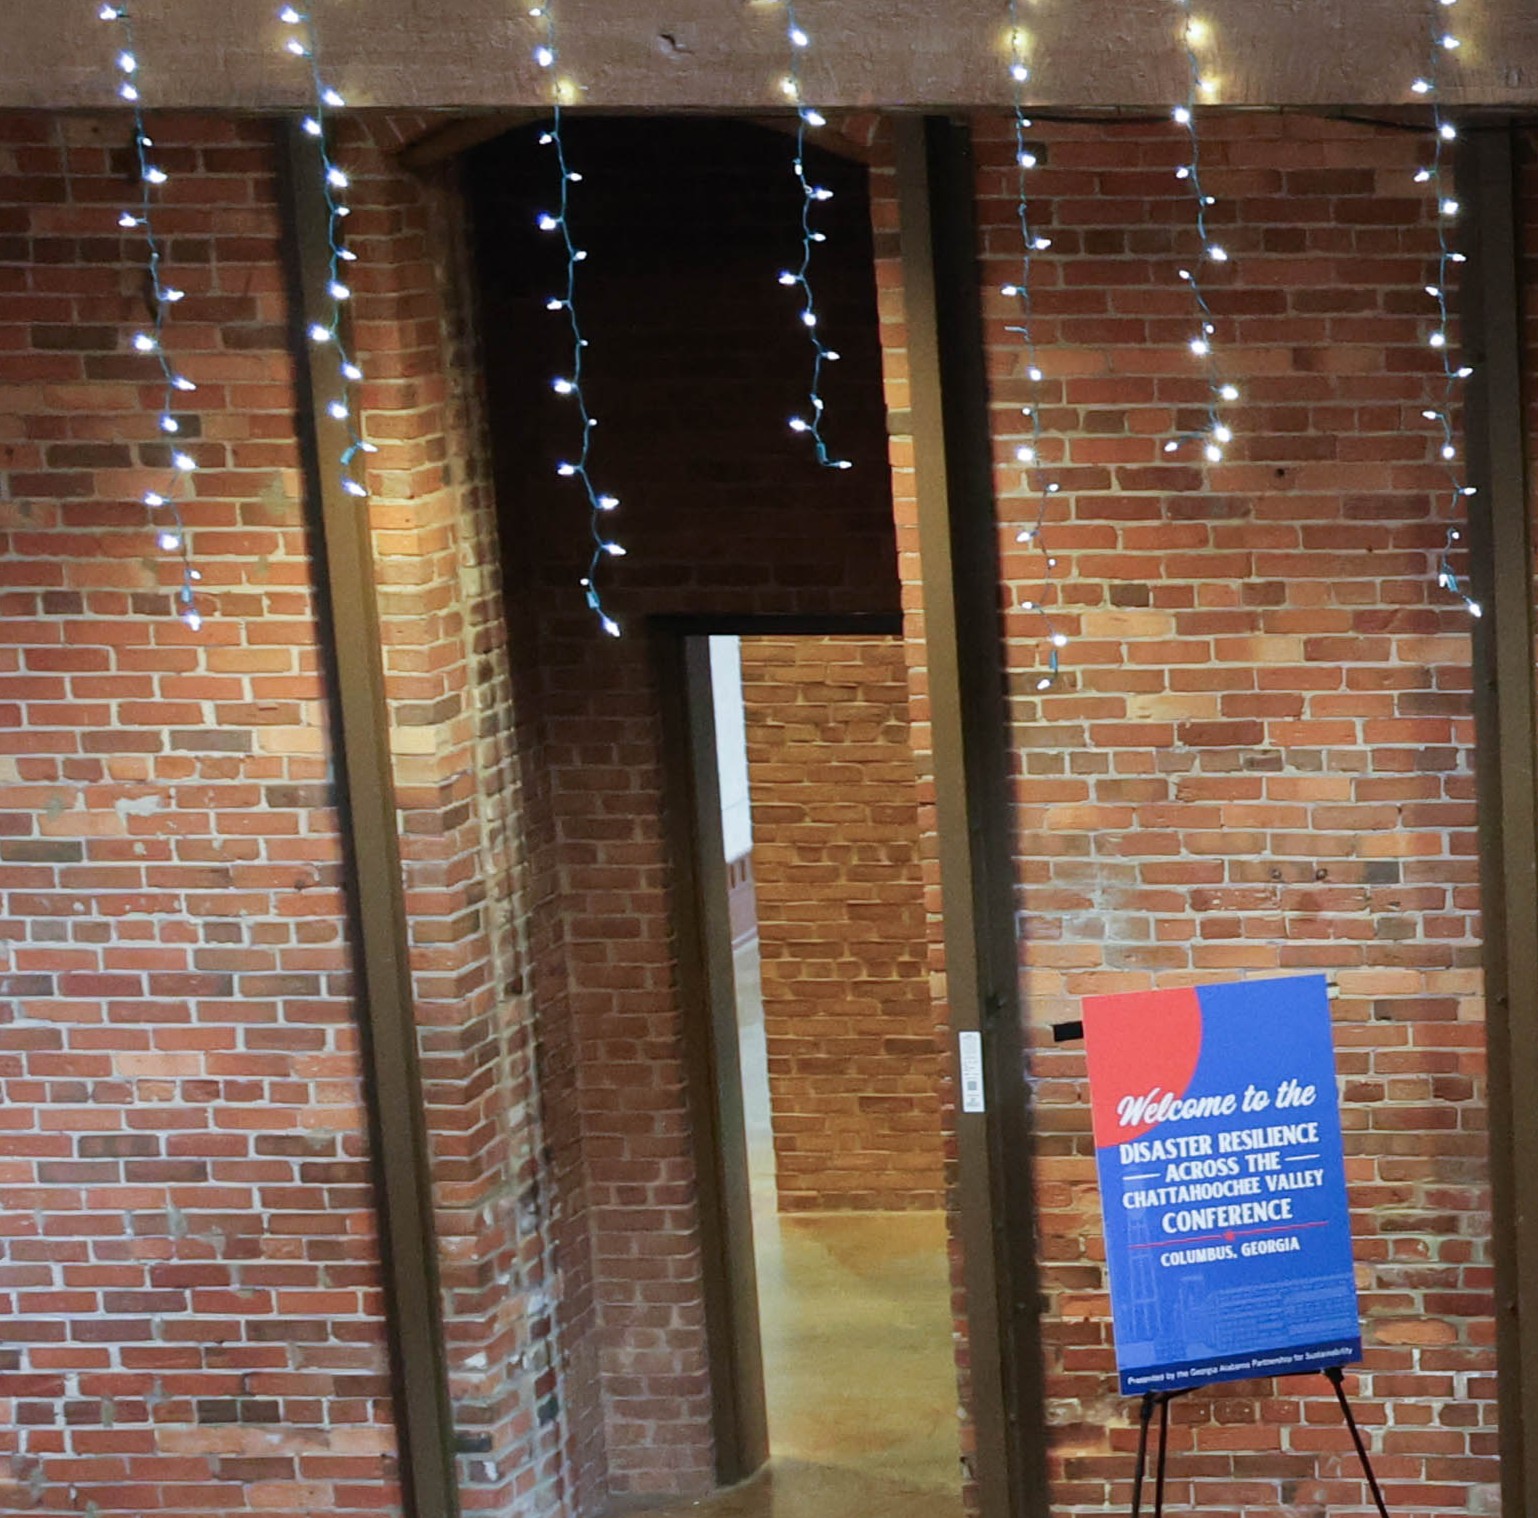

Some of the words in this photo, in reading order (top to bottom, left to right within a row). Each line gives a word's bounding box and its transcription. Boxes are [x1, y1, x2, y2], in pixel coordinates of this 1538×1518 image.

[1117, 1087, 1237, 1127] Welcome
[1241, 1084, 1270, 1112] to
[1274, 1079, 1317, 1109] the
[1119, 1135, 1213, 1165] DISASTER
[1218, 1122, 1319, 1154] RESILIENCE
[1165, 1157, 1240, 1183] ACROSS
[1245, 1152, 1281, 1173] THE
[1122, 1177, 1261, 1209] CHATTAHOOCHEE
[1265, 1169, 1324, 1192] VALLEY
[1161, 1198, 1293, 1234] CONFERENCE
[1241, 1237, 1300, 1257] GEORGIA
[1127, 1373, 1164, 1385] Presented
[1166, 1371, 1175, 1381] by
[1176, 1370, 1189, 1378] the
[1190, 1367, 1218, 1377] Georgia
[1293, 1353, 1304, 1362] for
